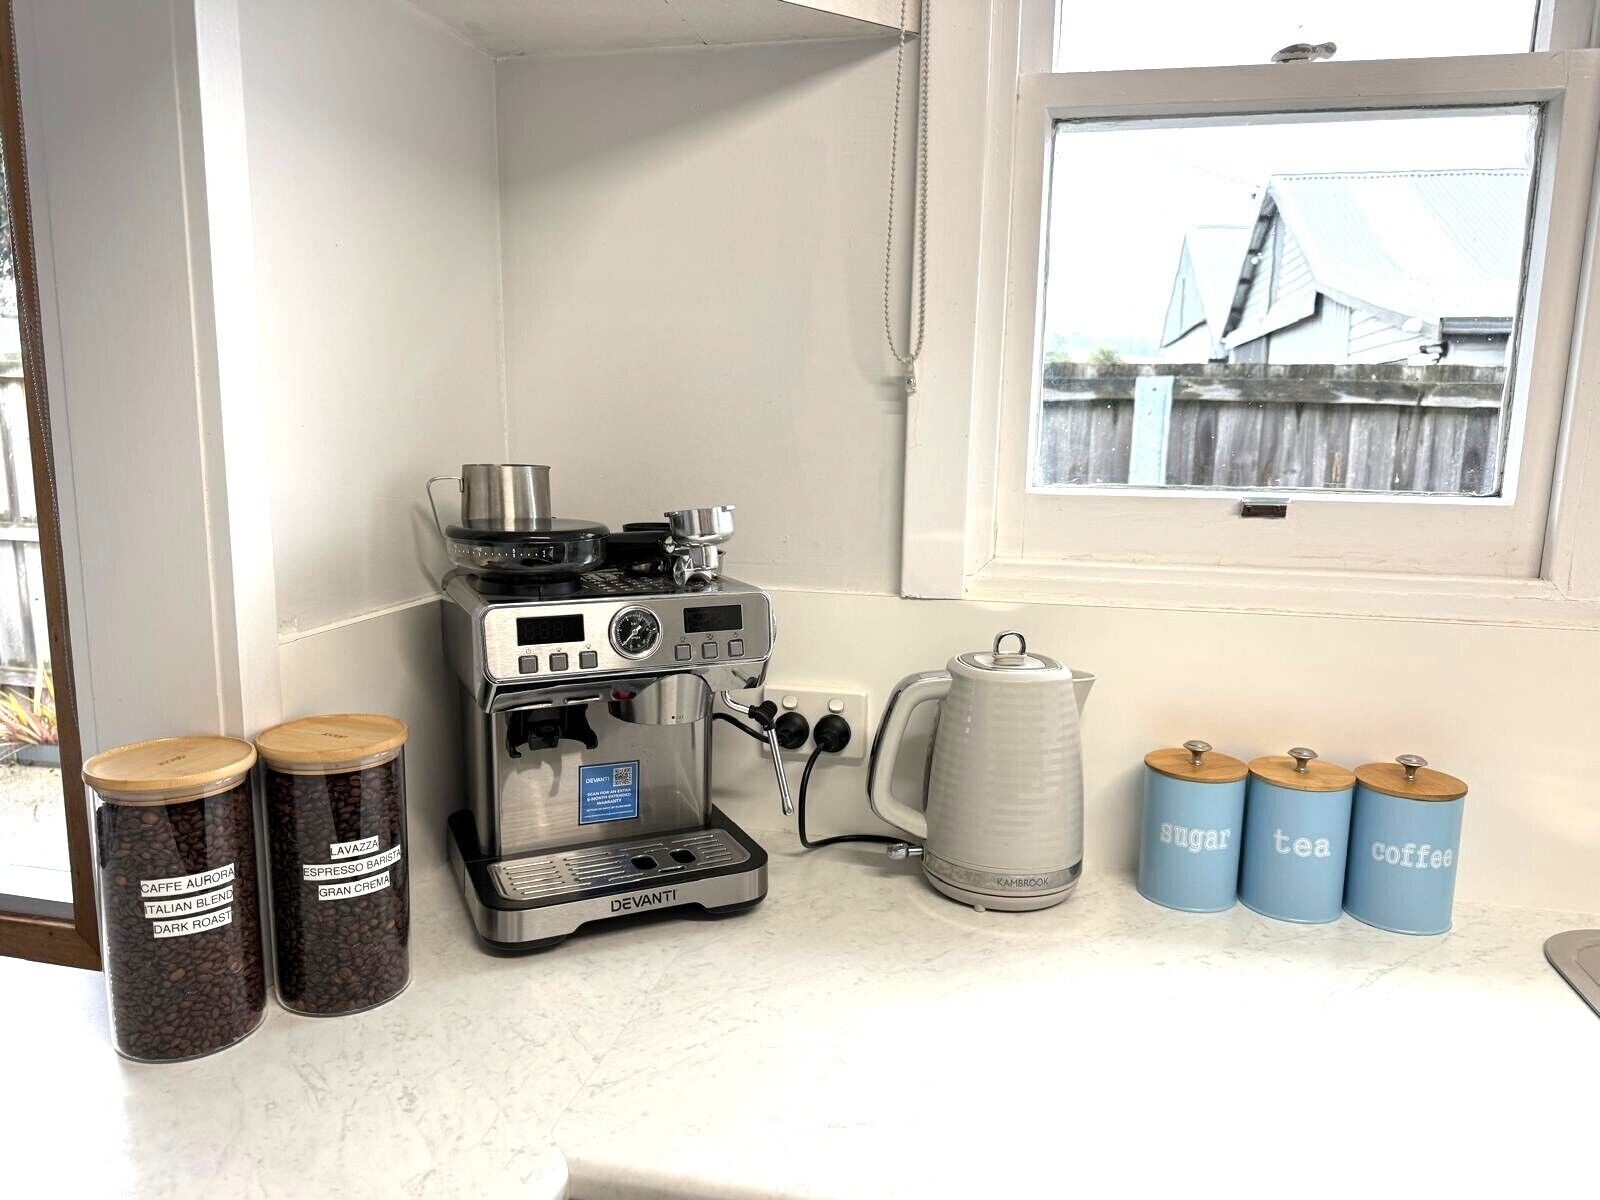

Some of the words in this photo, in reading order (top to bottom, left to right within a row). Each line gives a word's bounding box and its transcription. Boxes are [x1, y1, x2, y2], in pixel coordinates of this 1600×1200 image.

[585, 776, 610, 784] DEVANTI
[330, 839, 378, 856] LAVAZZA
[1160, 823, 1231, 853] sugar
[1273, 828, 1331, 858] tea
[303, 862, 363, 877] ESPRESSO
[366, 848, 400, 870] BARISTA
[1371, 842, 1453, 869] coffee
[141, 881, 182, 894] CAFFE
[186, 867, 234, 889] AURORA
[319, 885, 351, 897] GRAN
[354, 874, 390, 893] CREMA
[997, 878, 1049, 888] KAMBROOK
[144, 900, 192, 915] ITALIAN
[196, 889, 233, 909] BLEND
[610, 889, 676, 913] DEVANTI
[153, 922, 189, 935] DARK
[192, 910, 232, 930] ROAST
